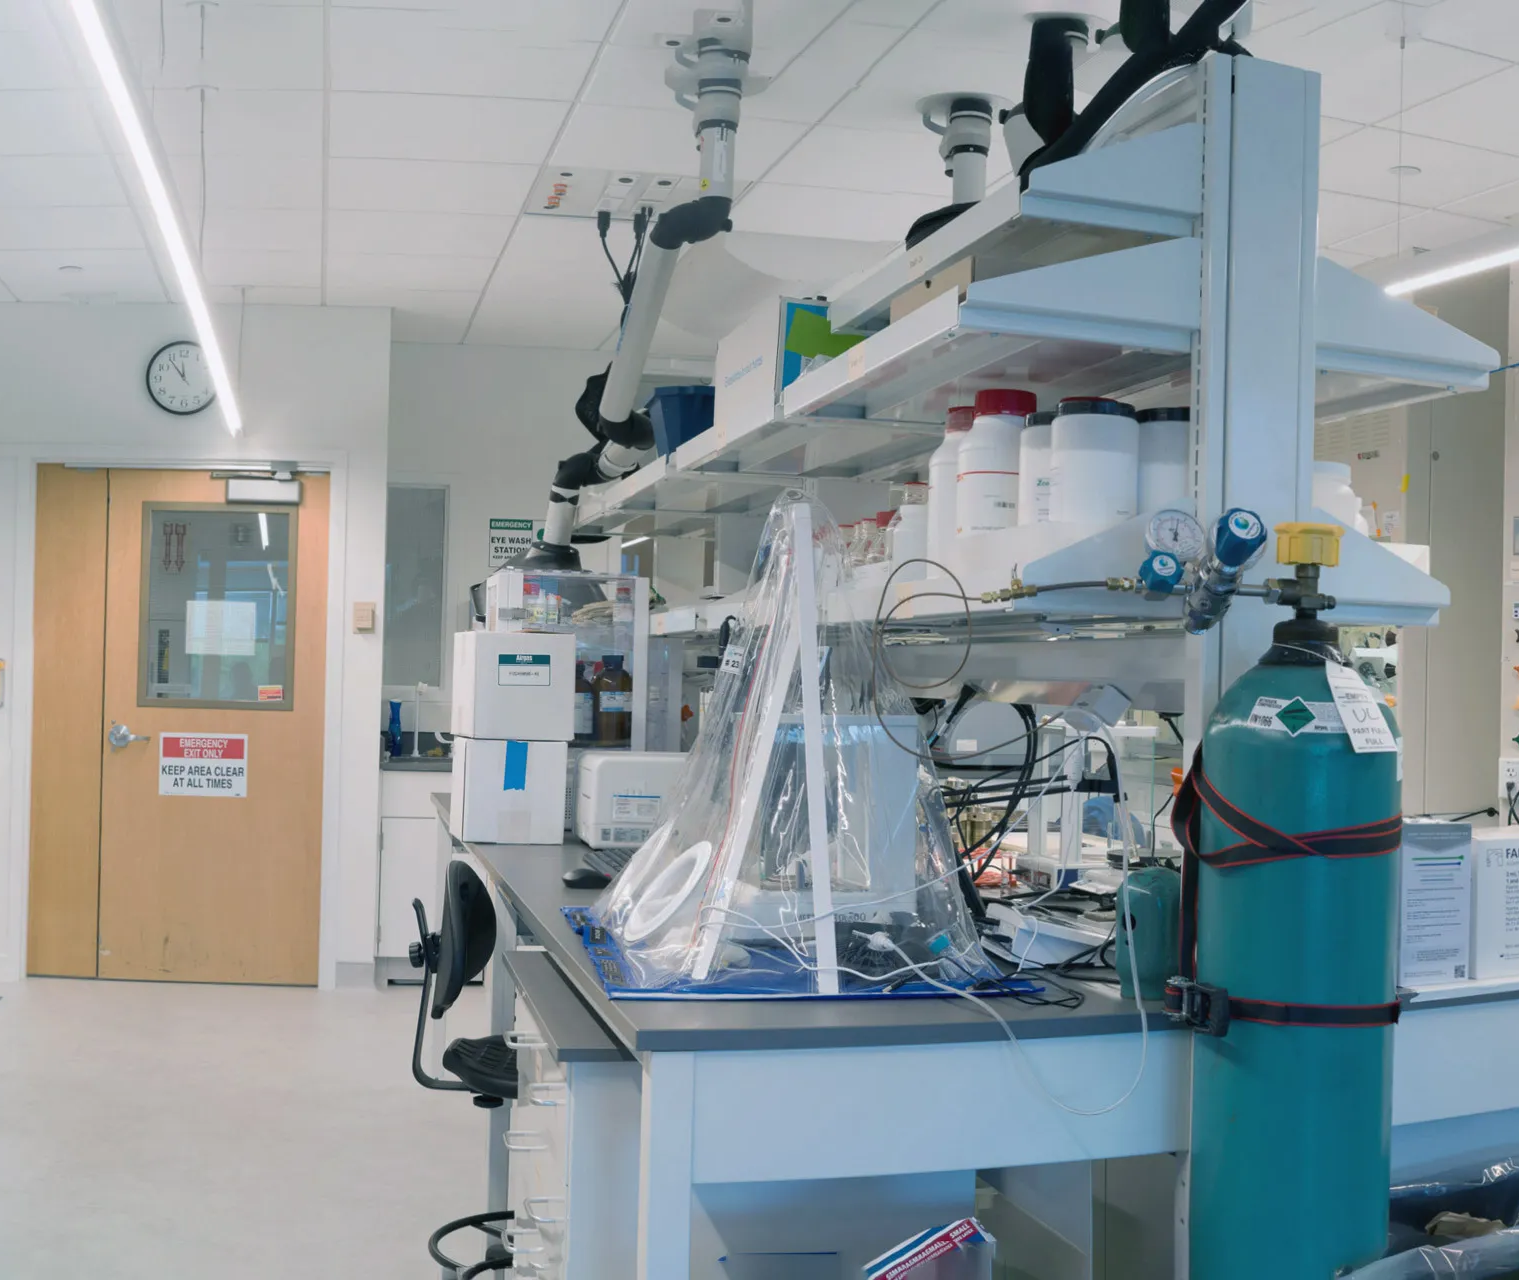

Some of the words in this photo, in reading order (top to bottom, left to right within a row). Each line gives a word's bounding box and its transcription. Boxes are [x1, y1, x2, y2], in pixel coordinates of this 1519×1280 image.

[491, 521, 532, 529] EMERGENCY
[508, 536, 532, 544] WASH
[180, 738, 228, 748] EMERGENCY
[184, 748, 201, 757] EXIT
[203, 749, 224, 758] ONLY
[162, 765, 185, 775] KEEP
[187, 766, 212, 776] AREA
[214, 766, 245, 777] CLEAR
[173, 777, 185, 787] AT
[187, 778, 204, 788] ALL
[206, 778, 233, 789] TIMES
[949, 1223, 971, 1239] SMALL
